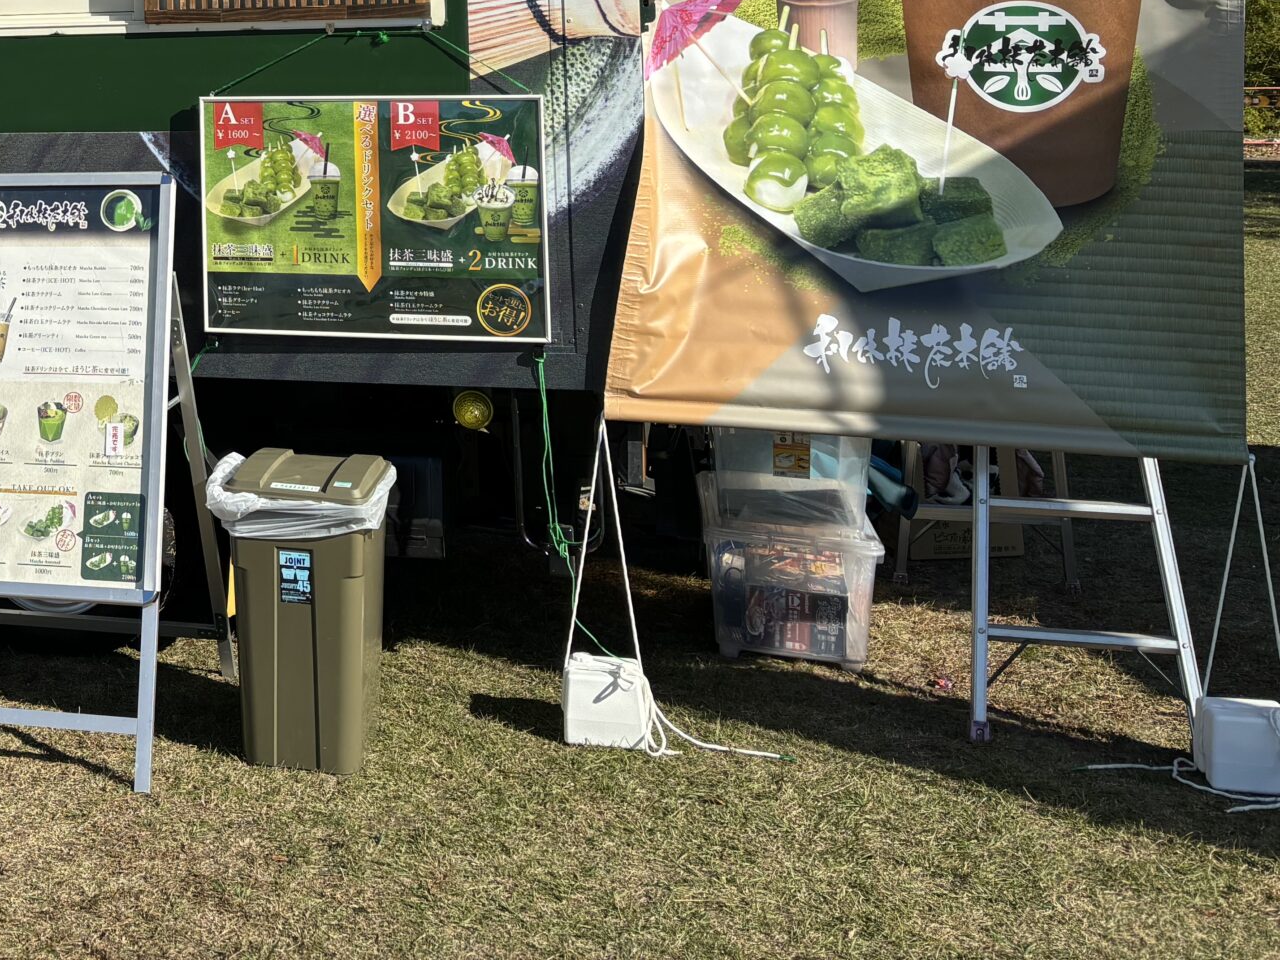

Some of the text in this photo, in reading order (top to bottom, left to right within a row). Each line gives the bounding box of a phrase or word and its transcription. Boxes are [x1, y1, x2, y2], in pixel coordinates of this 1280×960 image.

[218, 103, 255, 125] A SET
[396, 102, 432, 125] B SET
[228, 129, 249, 139] 1600
[356, 104, 377, 231] 選べるドリンクセット
[301, 252, 351, 264] DRINK
[468, 249, 482, 271] 2
[484, 257, 538, 269] DRINK
[803, 313, 1025, 389] 利休抹茶本舗
[12, 483, 34, 492] TAKE
[284, 556, 306, 566] JOINT
